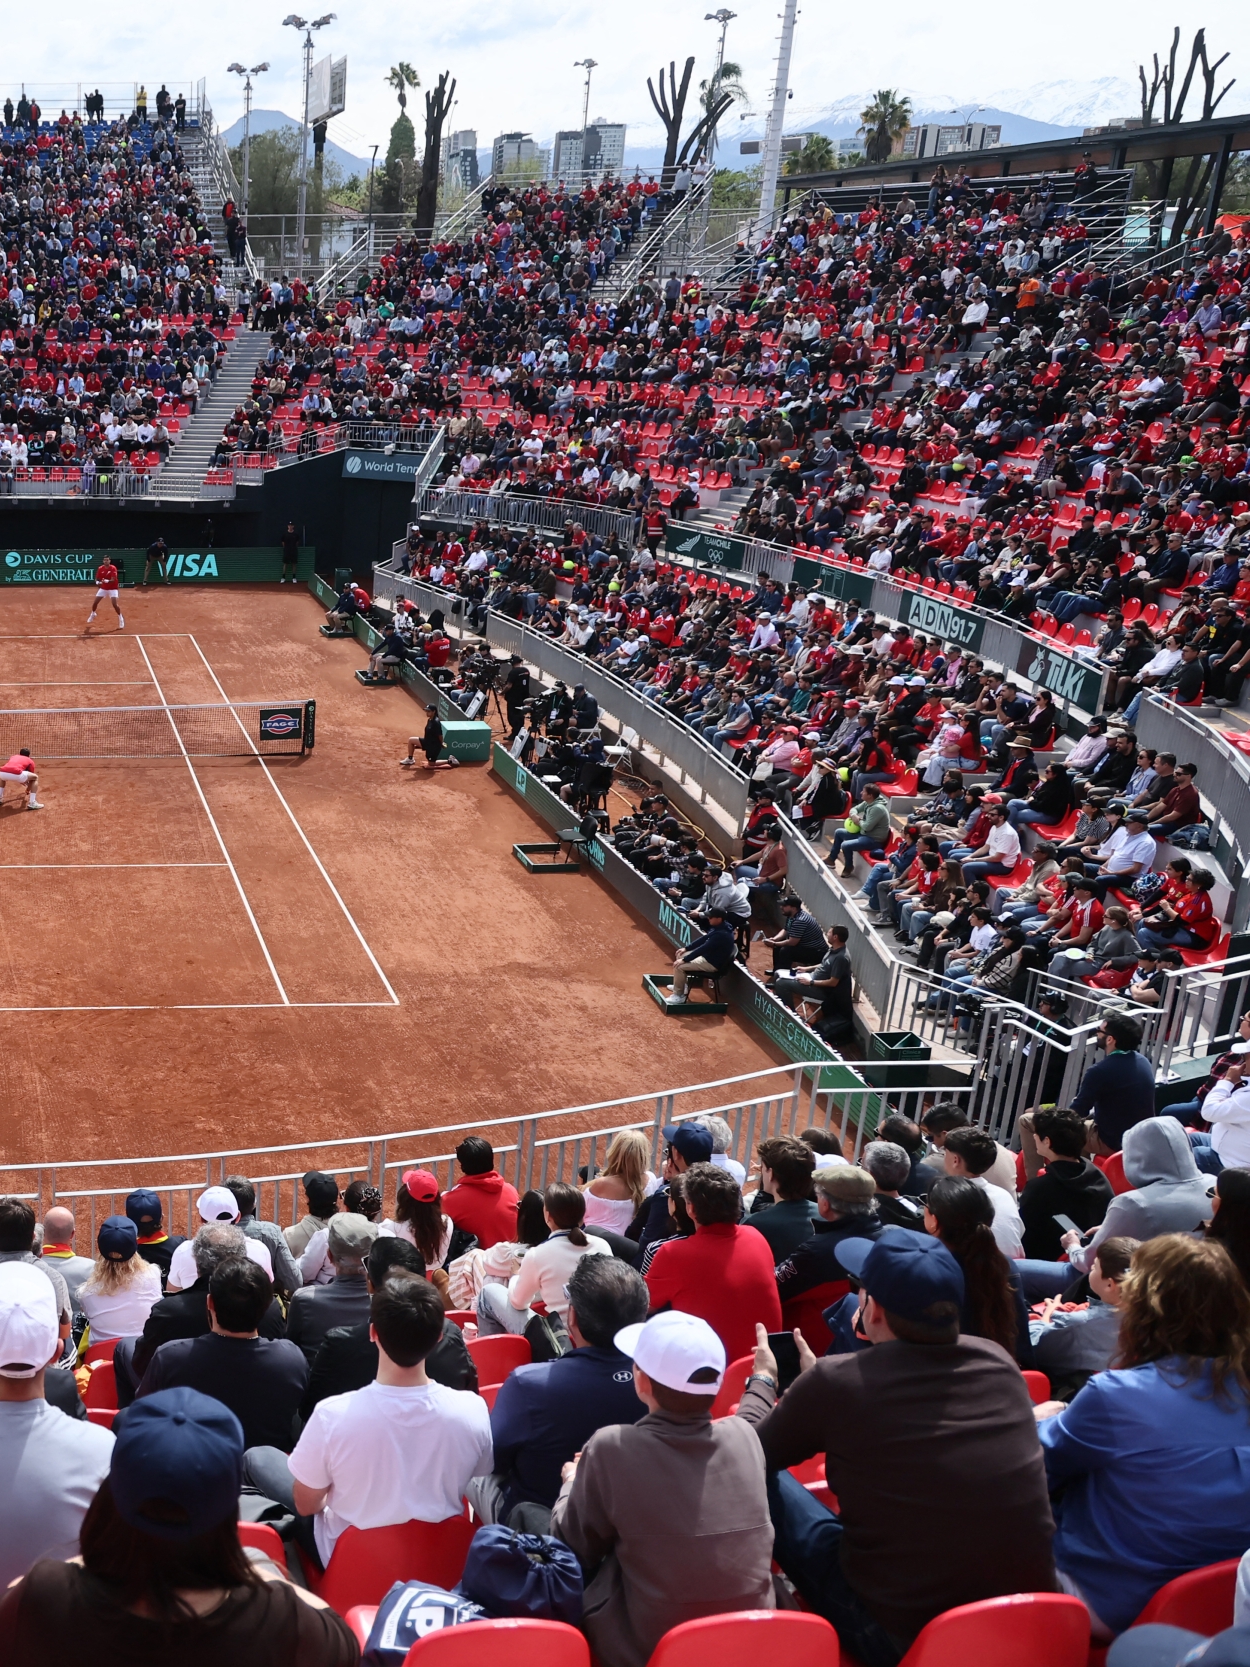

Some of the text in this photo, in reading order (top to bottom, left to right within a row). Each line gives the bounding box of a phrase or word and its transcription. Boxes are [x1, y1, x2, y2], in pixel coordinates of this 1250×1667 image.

[364, 460, 393, 472] World
[703, 535, 732, 550] TEAMCHILE
[24, 554, 93, 564] DAVIS CUP
[32, 568, 95, 581] GENERALI
[910, 600, 977, 643] ADN 91.7
[451, 740, 480, 750] Corpay
[754, 990, 785, 1029] HYATT
